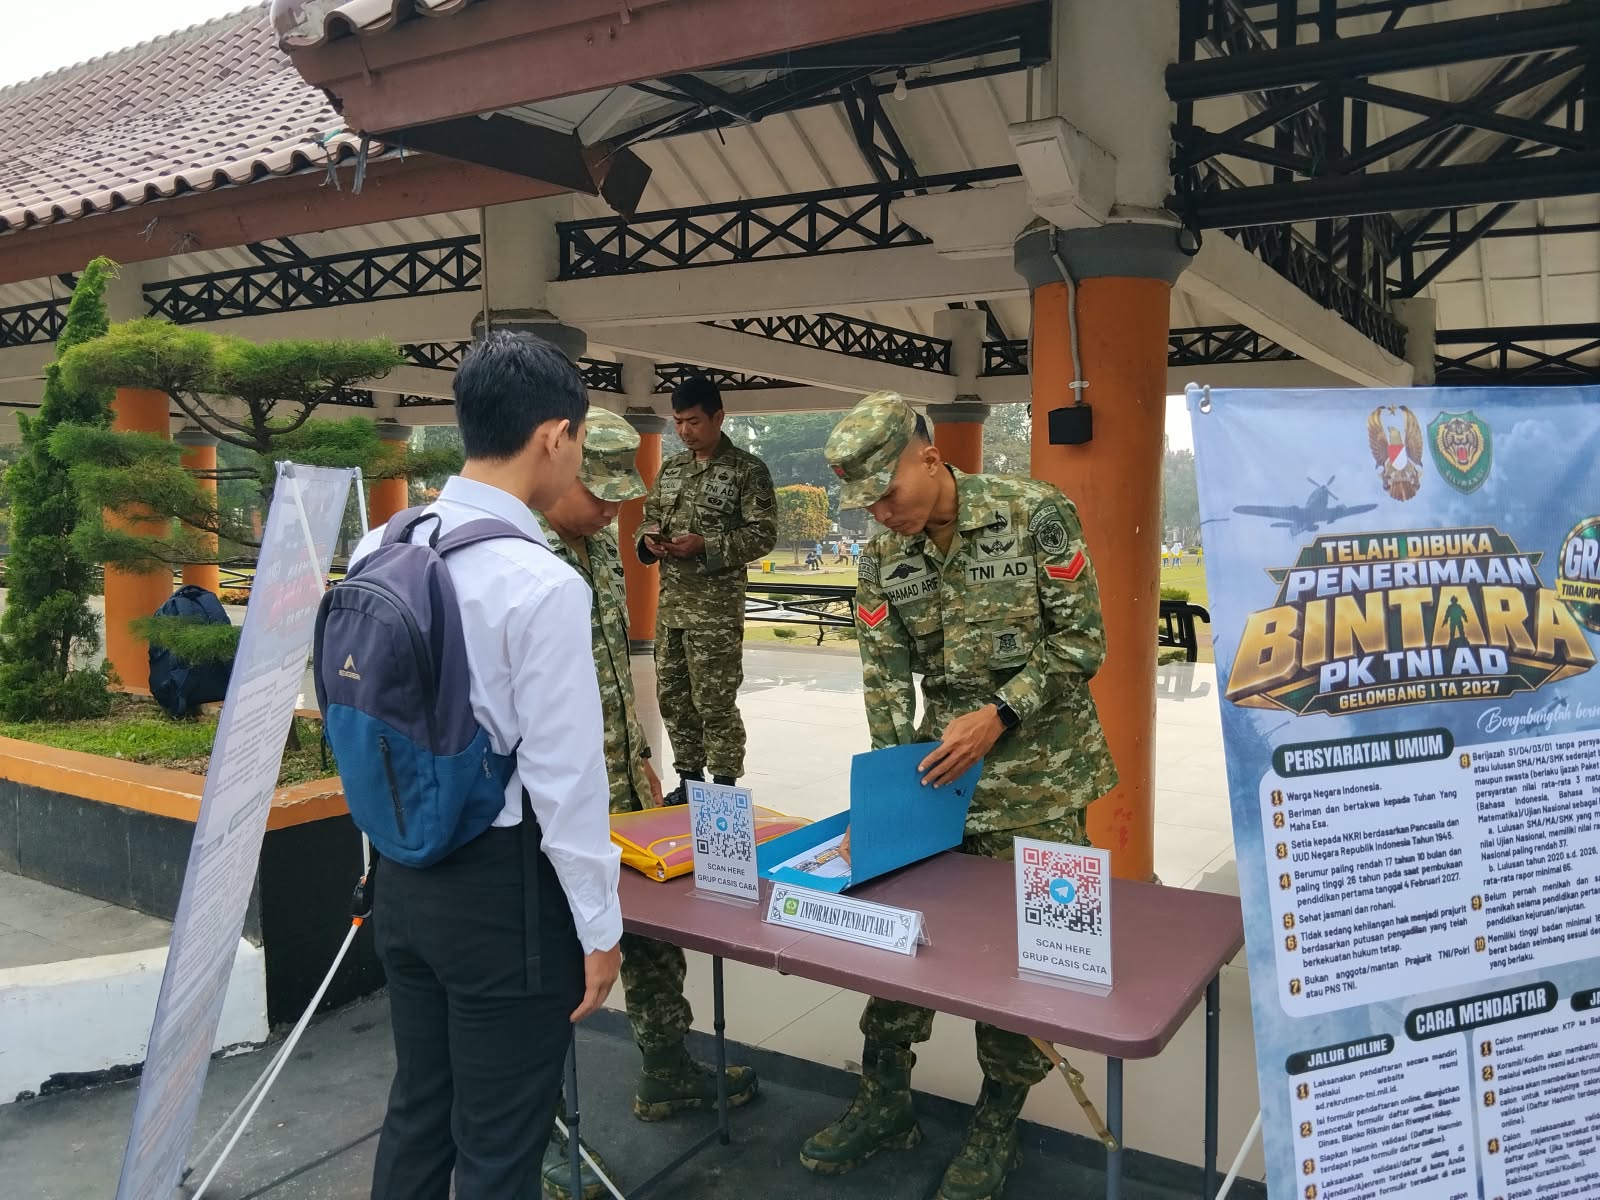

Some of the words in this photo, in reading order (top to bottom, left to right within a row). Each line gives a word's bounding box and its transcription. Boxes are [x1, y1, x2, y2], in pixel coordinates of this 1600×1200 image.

[706, 484, 717, 493] TNI
[721, 489, 734, 497] AD
[1321, 538, 1398, 563] TELAH
[1408, 533, 1492, 559] DIBUKA
[1564, 537, 1600, 579] GR
[922, 577, 938, 593] ARIF
[969, 566, 994, 581] TNI
[1003, 562, 1027, 576] AD
[1286, 557, 1537, 601] PENERIMAAN
[1562, 584, 1584, 597] TIDAK
[1225, 586, 1597, 701] BINTARA
[1320, 660, 1373, 692] PK
[1384, 650, 1443, 681] TNI
[1452, 648, 1508, 676] AD
[1339, 687, 1426, 709] GELOMBANG
[1431, 685, 1436, 699] I
[1439, 683, 1457, 698] TA
[1462, 681, 1499, 695] 2027
[1477, 704, 1571, 735] Bergabunglah
[1284, 742, 1391, 772] PERSYARATAN
[1396, 735, 1443, 760] UMUM
[1462, 756, 1468, 767] 8
[1472, 750, 1505, 761] Berijazah
[1555, 742, 1575, 750] tanpa
[1474, 766, 1490, 774] atau
[1491, 762, 1516, 771] lulusan
[1517, 753, 1564, 768] SMA/MA/SMK
[1566, 749, 1596, 761] sederajat
[1273, 792, 1280, 804] 1
[1286, 792, 1312, 802] Warga
[1313, 789, 1341, 799] Negara
[1342, 782, 1382, 794] Indonesia.
[1274, 814, 1283, 826] 2
[1288, 808, 1322, 818] Beriman
[1325, 805, 1340, 814] dan
[1343, 800, 1380, 812] bertakwa
[1384, 795, 1410, 807] kepada
[1413, 793, 1436, 802] Tuhan
[1439, 790, 1457, 799] Yang
[1278, 844, 1286, 857] 3
[1291, 838, 1312, 849] Setia
[1313, 834, 1342, 847] kepada
[1342, 832, 1362, 842] NKRI
[1363, 826, 1410, 839] berdasarkan
[1410, 820, 1445, 832] Pancasila
[1446, 819, 1459, 827] dan
[1290, 822, 1310, 832] Maha
[1312, 820, 1328, 829] Esa.
[1292, 852, 1310, 862] UUD
[1311, 850, 1339, 860] Negara
[1340, 843, 1374, 856] Republik
[1375, 838, 1411, 851] Indonesia
[1412, 835, 1434, 845] Tahun
[1481, 848, 1511, 861] Nasional
[1512, 846, 1533, 858] paling
[1534, 841, 1558, 852] rendah
[1559, 839, 1568, 848] 37.
[708, 863, 726, 872] SCAN
[728, 867, 745, 875] HERE
[1280, 875, 1289, 888] 4
[1294, 868, 1328, 880] Berumur
[1331, 864, 1354, 876] paling
[1356, 859, 1383, 870] rendah
[1385, 857, 1392, 866] 17
[1394, 856, 1415, 865] tahun
[1417, 852, 1425, 861] 10
[1426, 850, 1447, 860] bulan
[1449, 848, 1462, 856] dan
[1296, 882, 1320, 895] paling
[1322, 877, 1344, 890] tinggi
[1359, 874, 1381, 883] tahun
[1383, 869, 1402, 881] pada
[1403, 867, 1419, 876] saat
[1421, 860, 1463, 875] pembukaan
[1483, 874, 1514, 886] rata-rata
[1516, 871, 1534, 881] rapor
[1535, 864, 1562, 877] minimal
[718, 878, 737, 887] CASIS
[739, 882, 757, 891] CABA
[1297, 893, 1340, 908] pendidikan
[1341, 888, 1374, 901] pertama
[1375, 882, 1403, 894] tanggal
[1410, 875, 1440, 888] Februari
[1442, 872, 1461, 883] 2027.
[1473, 897, 1479, 909] 9
[1484, 892, 1507, 902] Belum
[1512, 886, 1536, 899] pernah
[1542, 880, 1571, 892] menikah
[1576, 877, 1589, 885] dan
[800, 901, 841, 926] INFORMASI
[841, 914, 896, 938] PENDAFTARAN
[1284, 915, 1293, 927] 5
[1299, 912, 1322, 924] Sehat
[1323, 906, 1353, 922] jasmani
[1354, 905, 1369, 914] dan
[1370, 900, 1396, 912] rohani.
[1287, 936, 1295, 949] 6
[1300, 930, 1322, 941] Tidak
[1324, 926, 1352, 937] sedang
[1353, 919, 1394, 932] kehilangan
[1396, 915, 1409, 925] hak
[1410, 909, 1439, 922] menjadi
[1440, 905, 1467, 918] prajurit
[1036, 939, 1062, 950] SCAN
[1066, 944, 1091, 955] HERE
[1302, 940, 1350, 954] berdasarkan
[1353, 934, 1384, 947] putusan
[1388, 926, 1427, 941] pengadilan
[1430, 922, 1447, 934] yang
[1450, 917, 1468, 928] telah
[1023, 952, 1048, 962] GRUP
[1051, 957, 1079, 968] CASIS
[1083, 963, 1107, 974] CATA
[1291, 981, 1299, 994] 7
[1304, 975, 1329, 985] Bukan
[1336, 961, 1399, 979] anggota/mantan
[1405, 953, 1432, 966] Prajurit
[1438, 945, 1470, 959] TNI/Polri
[1303, 953, 1351, 968] berkekuatan
[1352, 948, 1379, 959] hukum
[1380, 944, 1402, 954] tetap.
[1490, 959, 1506, 970] yang
[1507, 953, 1534, 965] berlaku.
[1306, 989, 1323, 998] atau
[1324, 984, 1341, 995] PNS
[1342, 981, 1357, 991] TNI.
[1415, 1009, 1456, 1035] CARA
[1459, 988, 1546, 1025] MENDAFTAR
[1495, 1037, 1513, 1046] Calon
[1517, 1026, 1559, 1040] menyerahkan
[1562, 1021, 1575, 1030] KTP
[1308, 1049, 1344, 1067] JALUR
[1348, 1039, 1387, 1059] ONLINE
[1496, 1044, 1525, 1056] terdekat.
[1313, 1074, 1356, 1088] Laksanakan
[1360, 1063, 1402, 1079] pendaftaran
[1406, 1057, 1429, 1067] secara
[1432, 1048, 1457, 1060] mandiri
